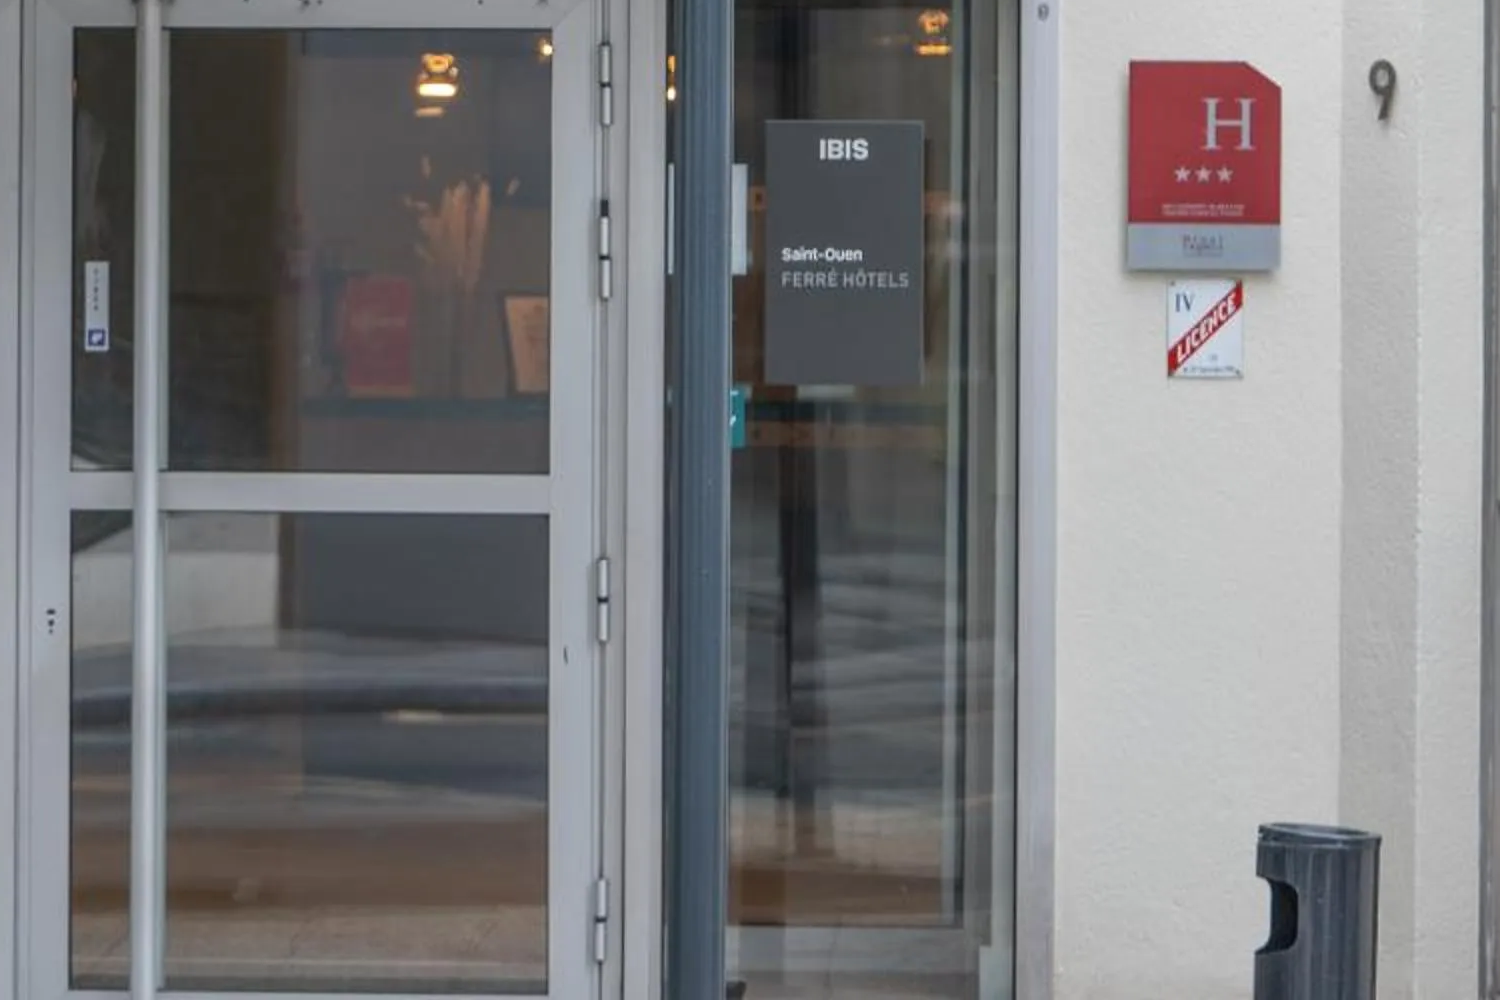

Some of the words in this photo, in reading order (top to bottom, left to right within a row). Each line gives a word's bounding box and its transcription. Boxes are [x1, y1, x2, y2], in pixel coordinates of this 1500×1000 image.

[1368, 59, 1397, 121] 9
[1200, 97, 1257, 151] H
[818, 138, 870, 161] IBIS
[780, 246, 864, 263] Saint-Ouen
[781, 268, 839, 288] FERRÉ
[842, 268, 910, 288] HÔTELS
[1174, 292, 1197, 313] IV
[1177, 291, 1238, 364] LICENCE
